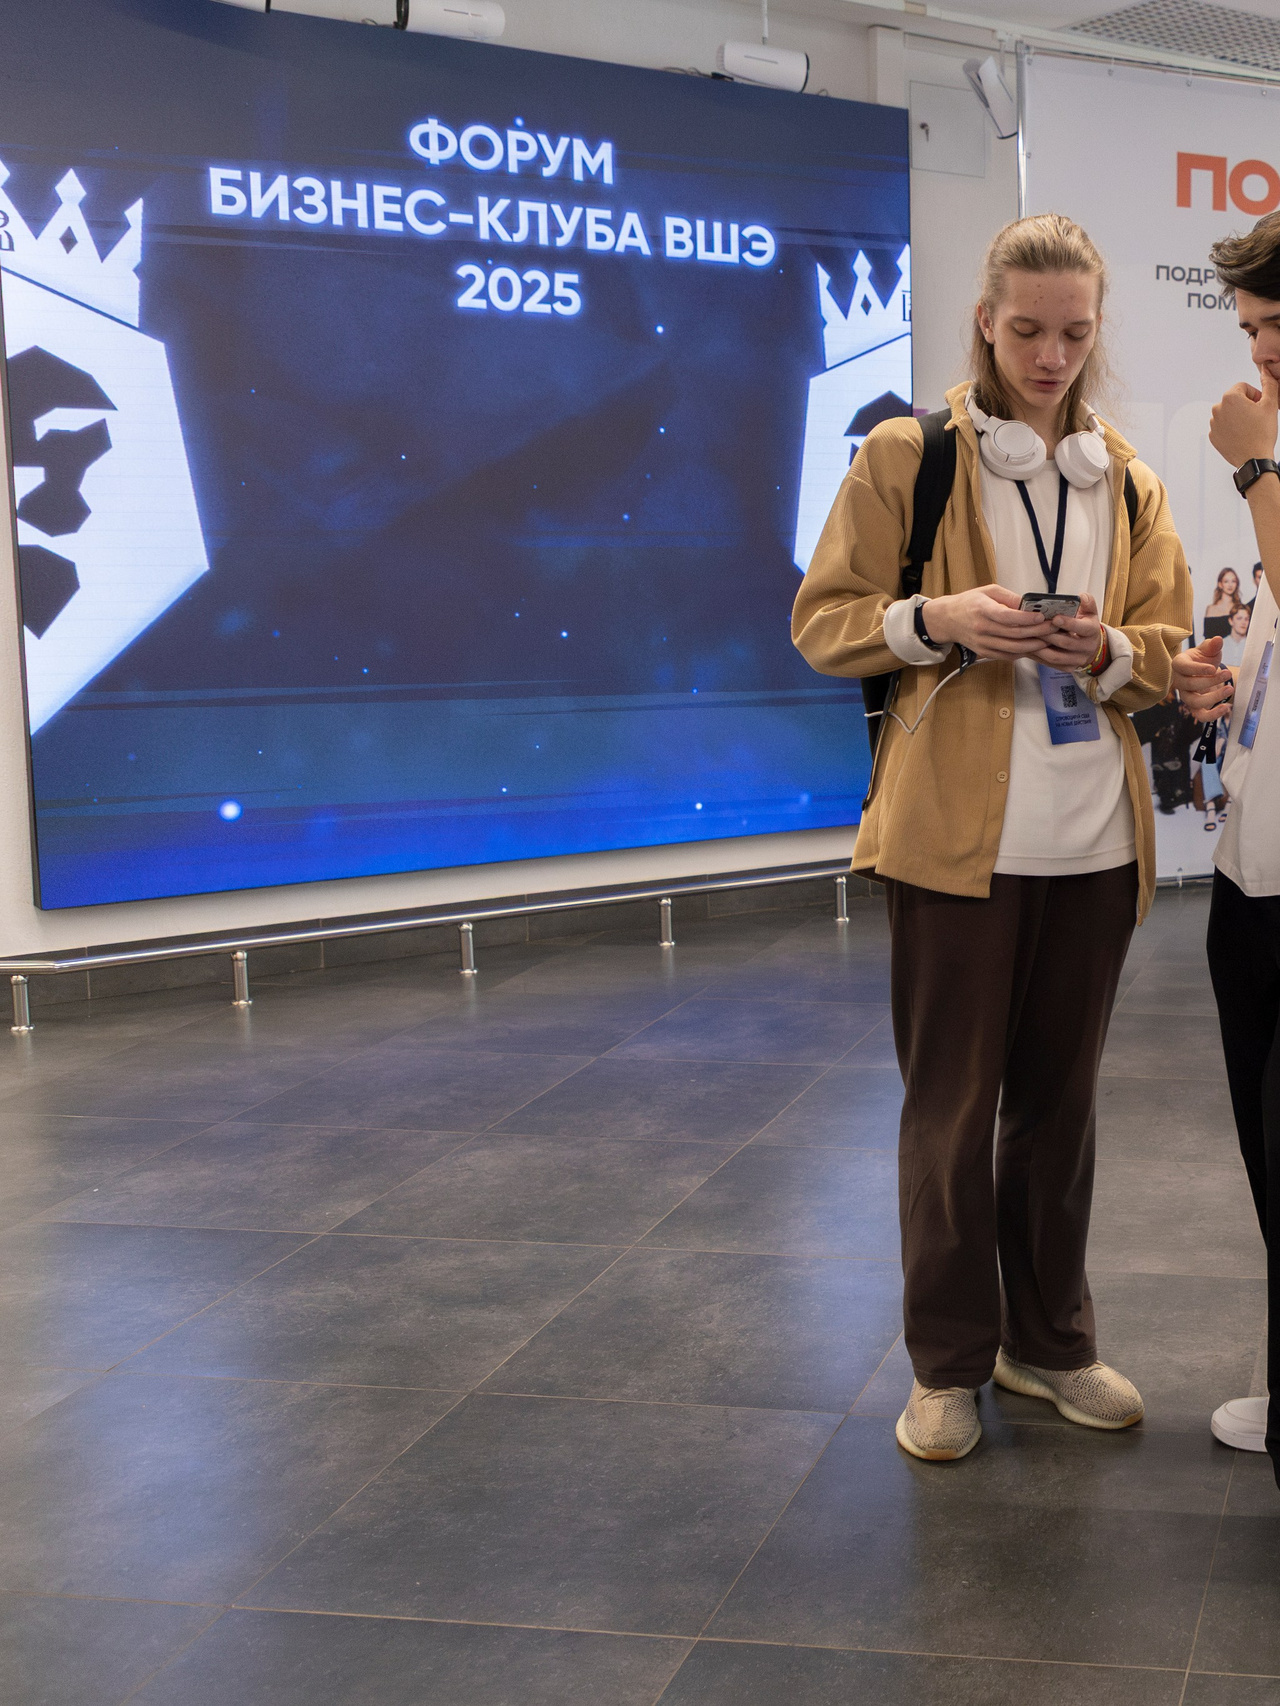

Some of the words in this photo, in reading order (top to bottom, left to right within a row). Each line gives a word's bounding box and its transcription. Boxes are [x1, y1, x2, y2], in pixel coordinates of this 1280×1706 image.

[409, 118, 613, 184] ФОРУМ
[209, 167, 651, 255] БИЗНЕС-КЛУБА
[664, 216, 776, 266] ВШЭ
[456, 264, 582, 315] 2025
[1156, 264, 1221, 286] ПОДР
[1187, 293, 1237, 311] ПОМ
